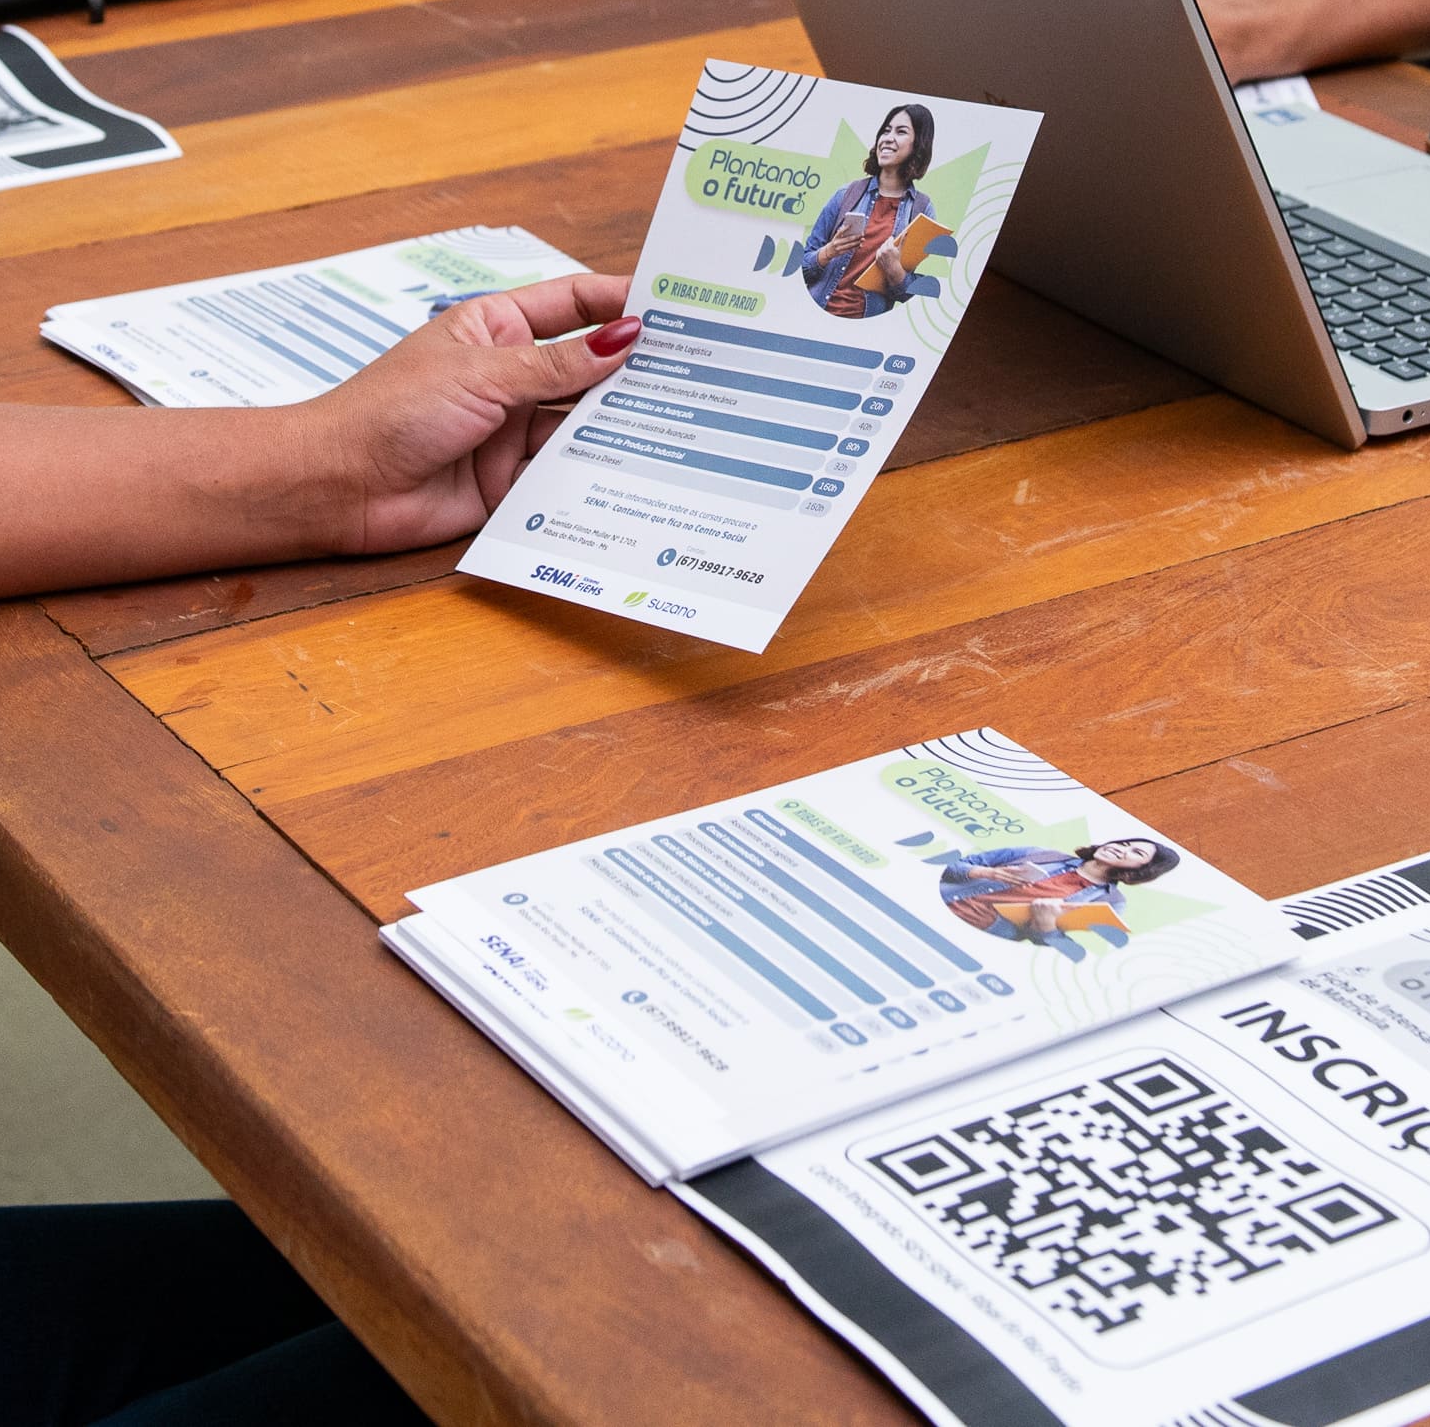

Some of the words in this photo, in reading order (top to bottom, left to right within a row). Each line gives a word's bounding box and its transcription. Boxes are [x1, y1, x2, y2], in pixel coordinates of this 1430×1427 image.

[710, 149, 821, 190] Plantando
[703, 178, 720, 198] o
[724, 176, 807, 216] futuro
[670, 281, 697, 301] RIBAS
[698, 286, 711, 304] DO
[711, 288, 728, 307] RIO
[728, 291, 759, 313] PARDO
[647, 313, 686, 331] Almoxarife
[641, 336, 675, 352] Assistente
[674, 342, 684, 352] de
[683, 343, 713, 358] Logística
[632, 357, 649, 368] Excel
[649, 359, 691, 376] Intermediário
[892, 359, 908, 370] 60h
[621, 377, 653, 391] Processos
[652, 383, 662, 392] de
[661, 383, 699, 400] Manutenção
[698, 391, 708, 400] de
[879, 380, 899, 391] 160h
[607, 395, 625, 406] Excel
[625, 398, 635, 407] do
[634, 400, 655, 412] Básico
[654, 405, 664, 414] ao
[663, 406, 695, 421] Avançado
[869, 401, 886, 412] 20h
[594, 412, 629, 427] Conectando
[664, 426, 698, 442] Avançado
[567, 446, 596, 460] Mecânica
[601, 453, 623, 467] Diesel
[580, 428, 614, 445] Assistente
[613, 436, 624, 445] de
[622, 438, 654, 455] Produção
[653, 445, 687, 461] Industrial
[845, 442, 861, 453] 80h
[583, 496, 609, 510] SENAI
[612, 503, 651, 522] Container
[650, 514, 667, 527] que
[667, 516, 683, 529] fica
[682, 522, 694, 531] no
[694, 524, 722, 538] Centro
[721, 529, 748, 543] Social
[589, 482, 608, 494] Para
[607, 488, 626, 499] mais
[625, 491, 668, 512] informações
[669, 502, 691, 516] sobre
[689, 509, 699, 517] os
[698, 511, 723, 524] cursos
[722, 516, 752, 530] procure
[675, 555, 699, 572] (67)
[698, 561, 765, 585] 99917-9628
[647, 597, 698, 619] suzano
[895, 776, 917, 789] o
[912, 785, 1000, 839] futuro
[917, 766, 1026, 836] Plantando
[1321, 971, 1359, 996] Ficha
[1357, 991, 1381, 1007] de
[1400, 977, 1425, 992] o
[1298, 977, 1322, 991] de
[1319, 987, 1392, 1033] Matrícula
